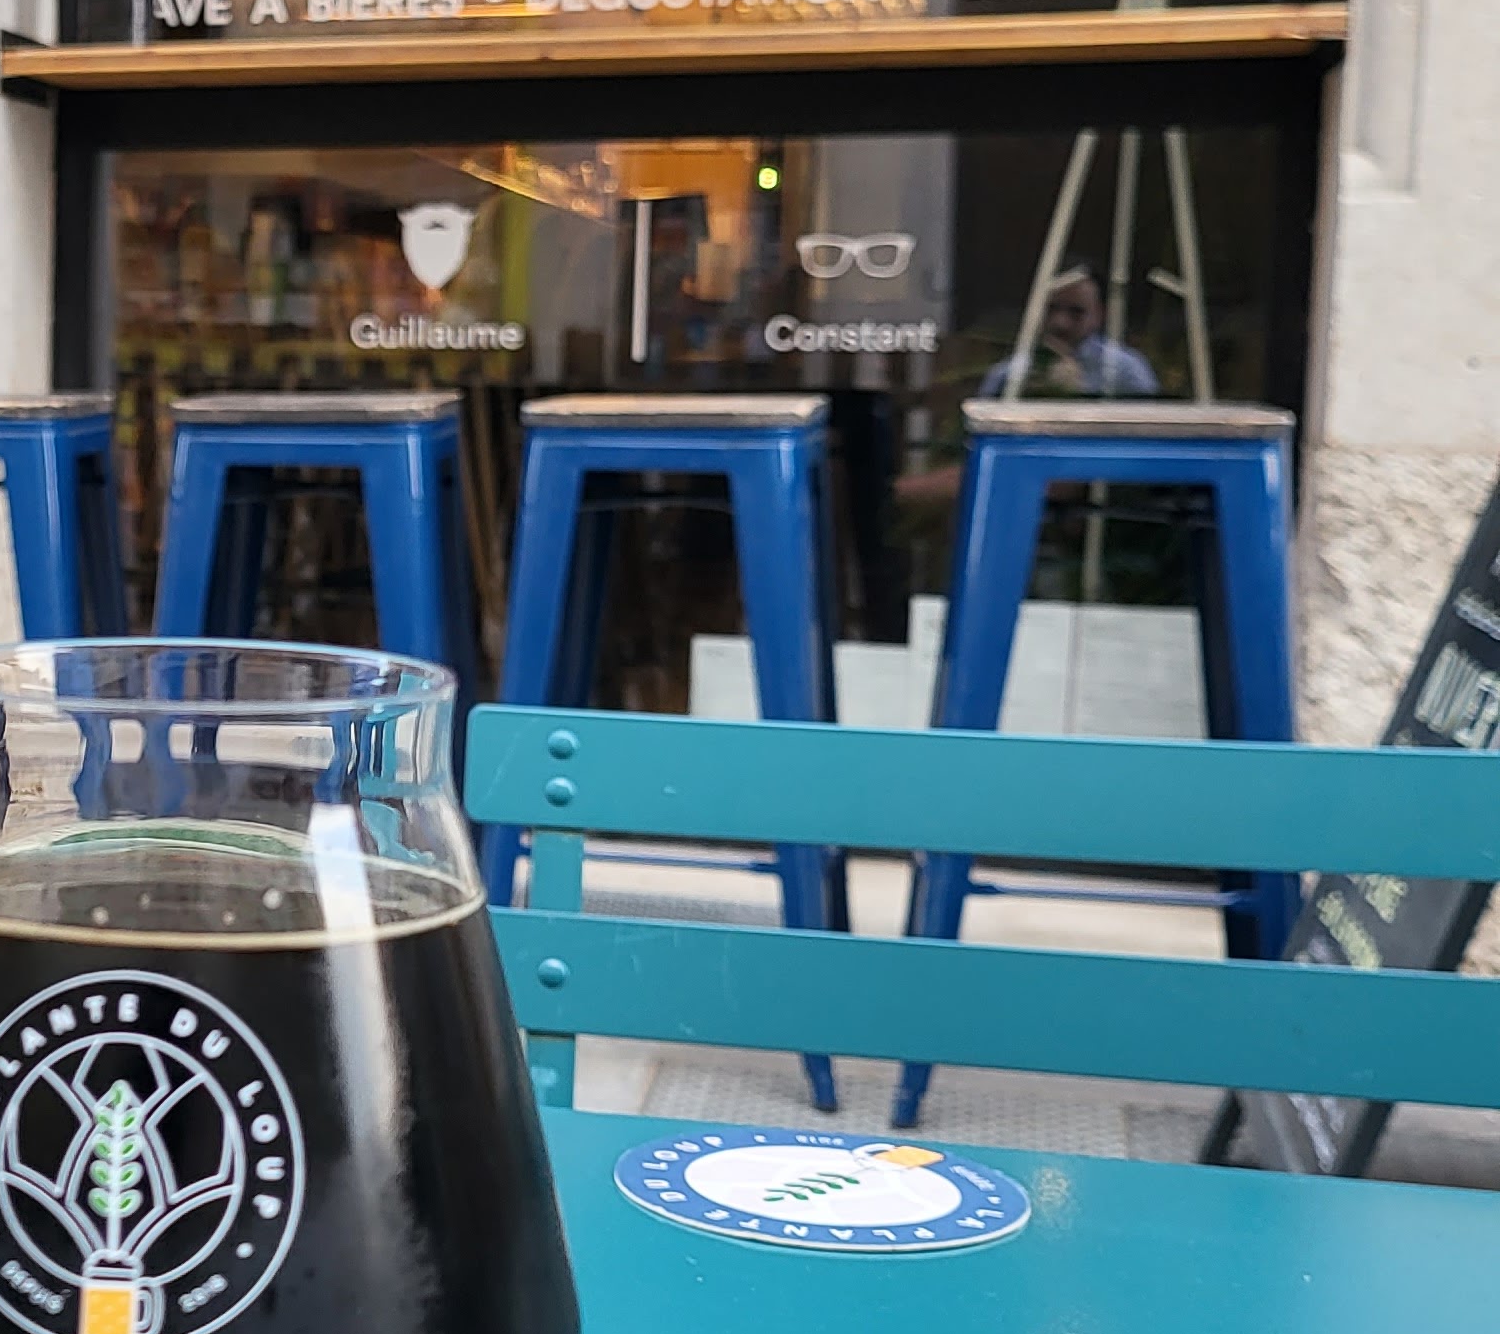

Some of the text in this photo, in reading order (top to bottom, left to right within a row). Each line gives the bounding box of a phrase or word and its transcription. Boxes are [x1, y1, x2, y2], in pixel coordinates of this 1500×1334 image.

[349, 312, 525, 352] Guillaume
[764, 313, 940, 354] Constant
[168, 1006, 232, 1061] DU
[237, 1079, 287, 1220] LOUP
